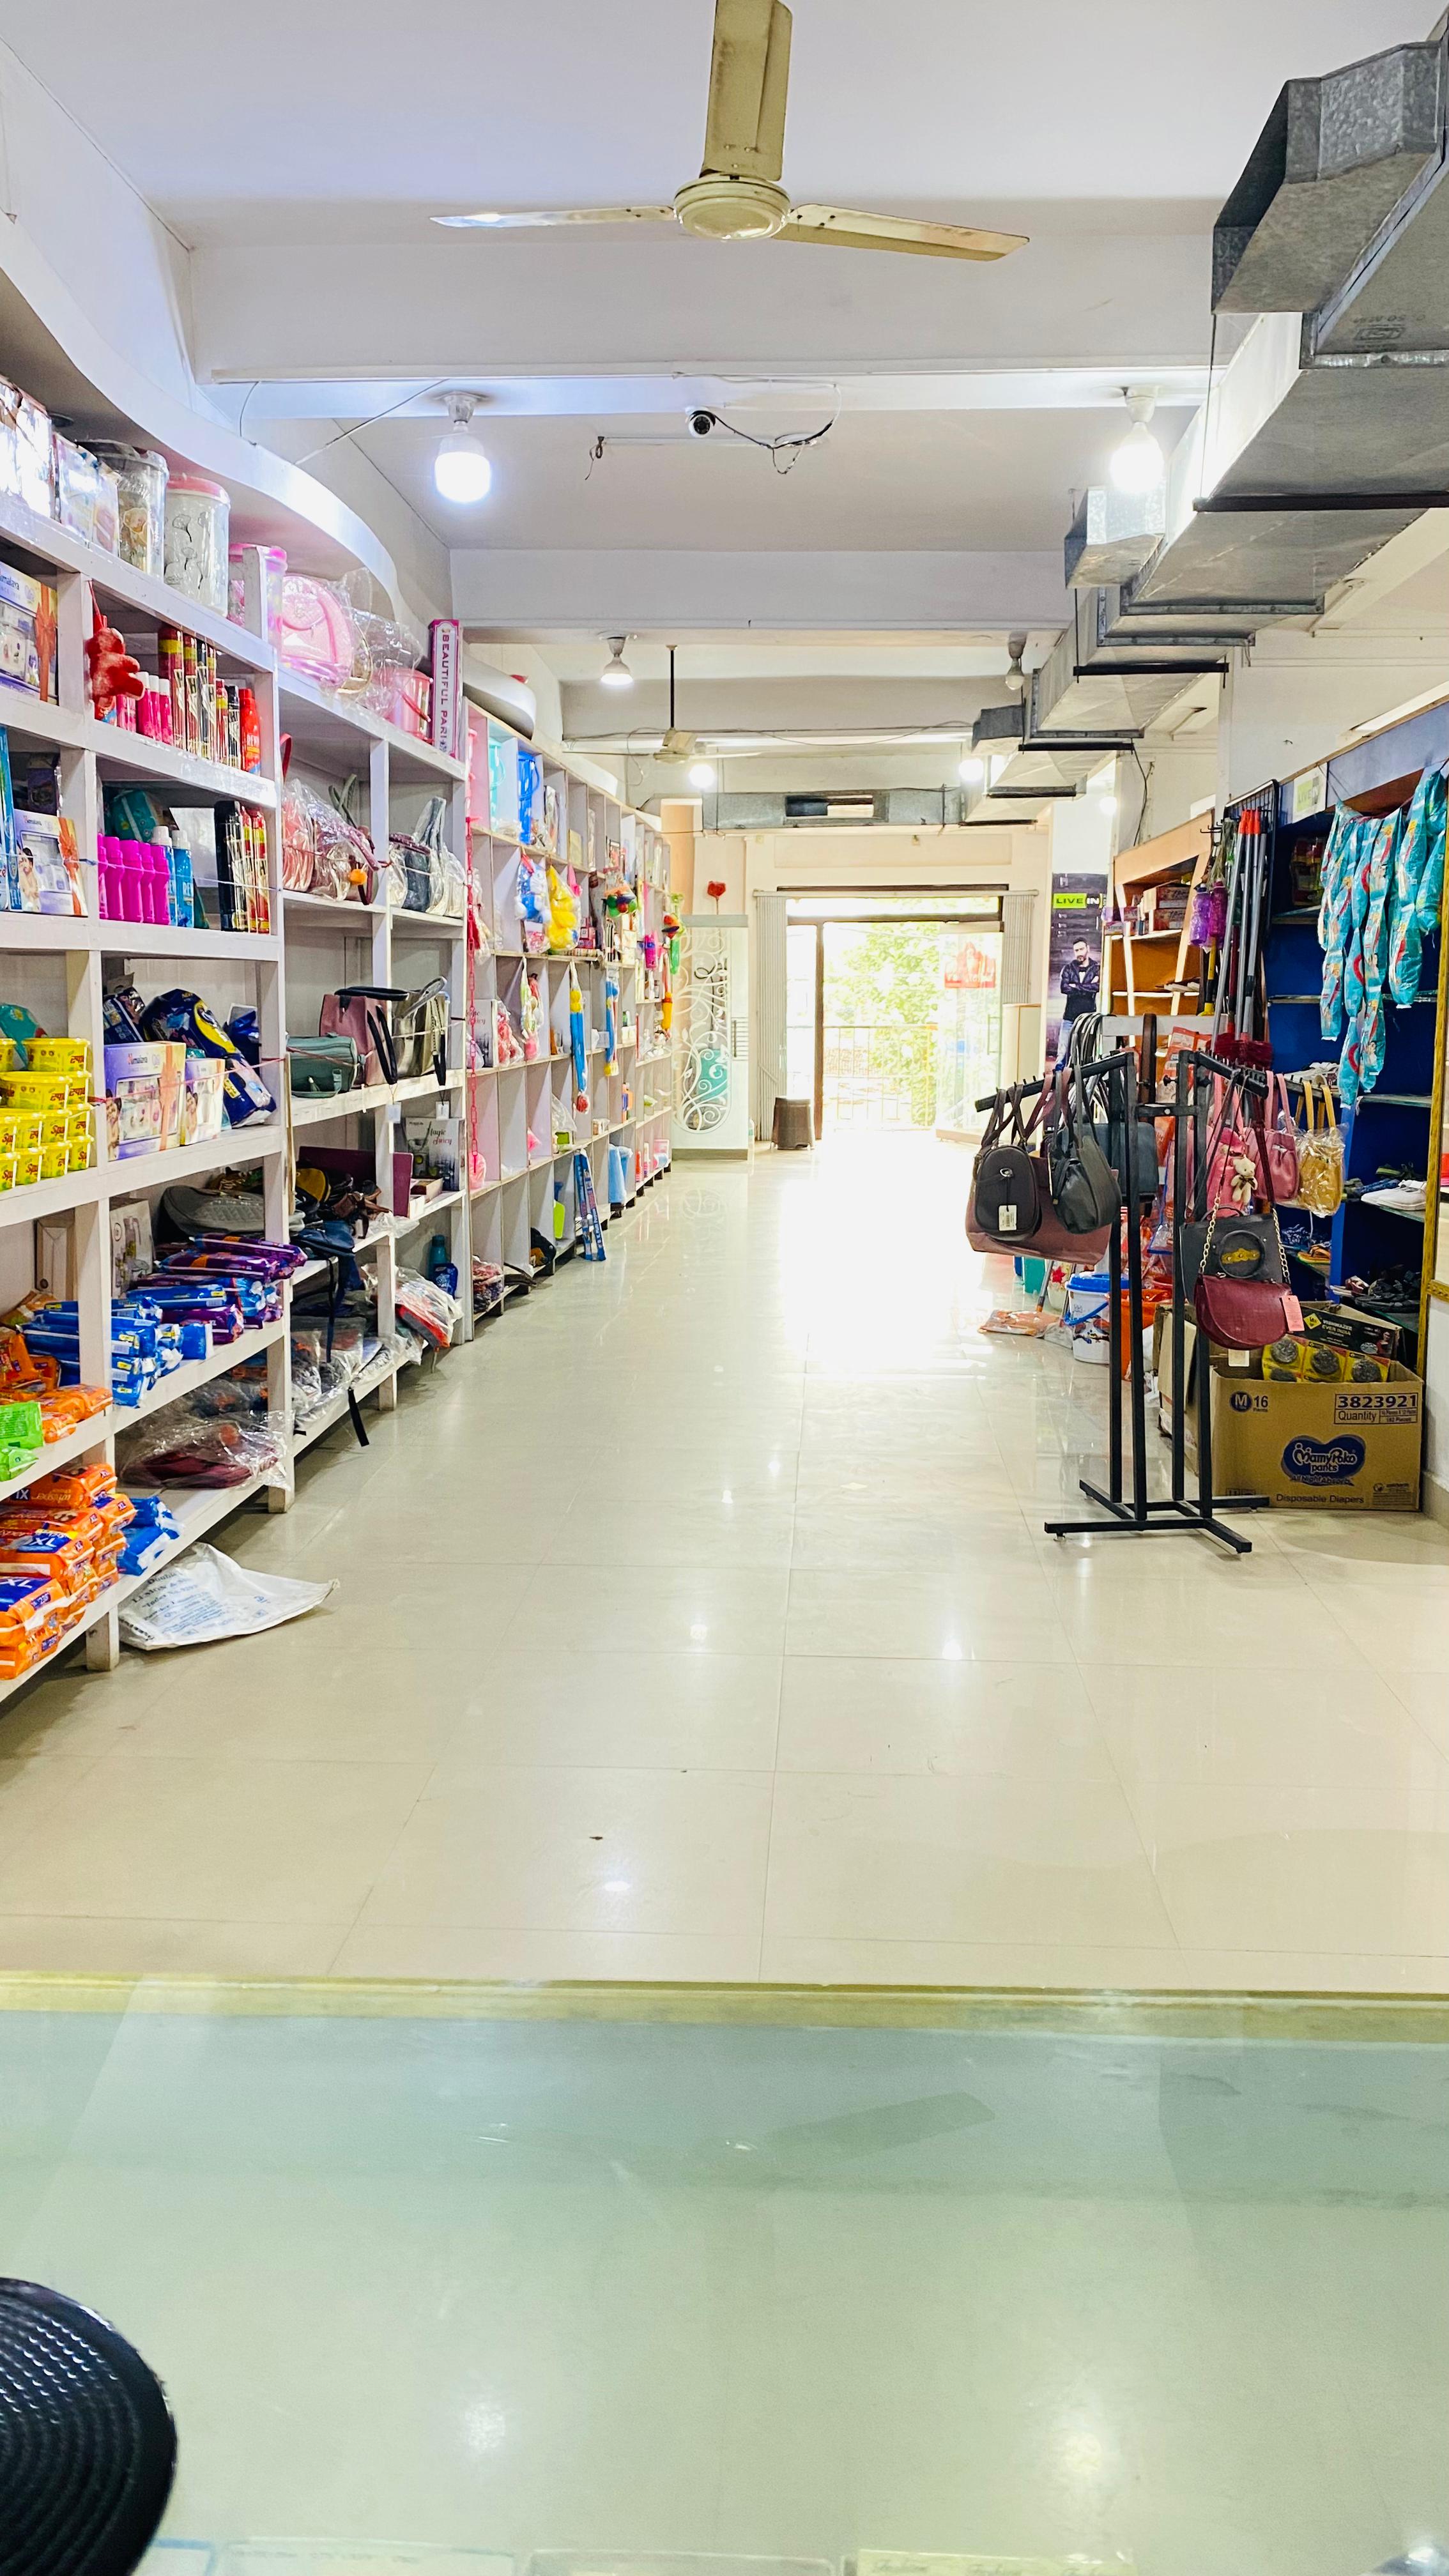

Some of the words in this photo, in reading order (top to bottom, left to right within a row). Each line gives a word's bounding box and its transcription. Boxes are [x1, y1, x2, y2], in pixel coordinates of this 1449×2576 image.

[441, 634, 449, 705] BEAUTIFUL
[1235, 1395, 1247, 1406] M
[1254, 1395, 1268, 1407] 16
[1337, 1395, 1416, 1408] 3823921
[1338, 1410, 1377, 1422] Quantity
[1310, 1462, 1338, 1474] pants
[1276, 1494, 1327, 1503] Disposable
[1330, 1495, 1365, 1503] Diapers
[29, 1537, 57, 1548] XL
[0, 1577, 34, 1590] XL
